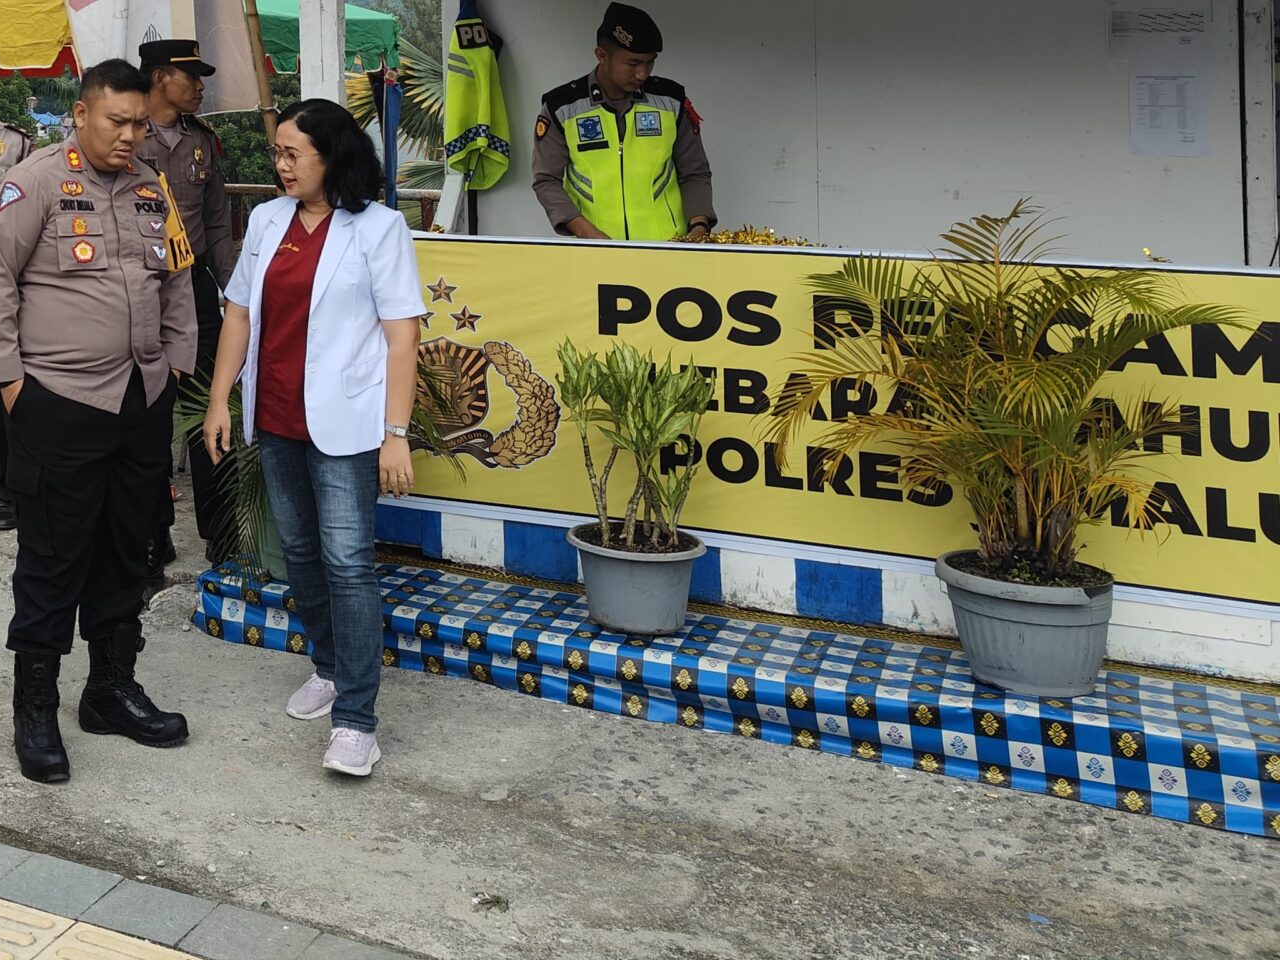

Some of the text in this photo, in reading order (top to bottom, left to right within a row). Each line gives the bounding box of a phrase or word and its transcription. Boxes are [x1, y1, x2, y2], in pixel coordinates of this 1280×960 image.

[598, 283, 1280, 383] POS PEGAM
[1072, 397, 1280, 464] AHU
